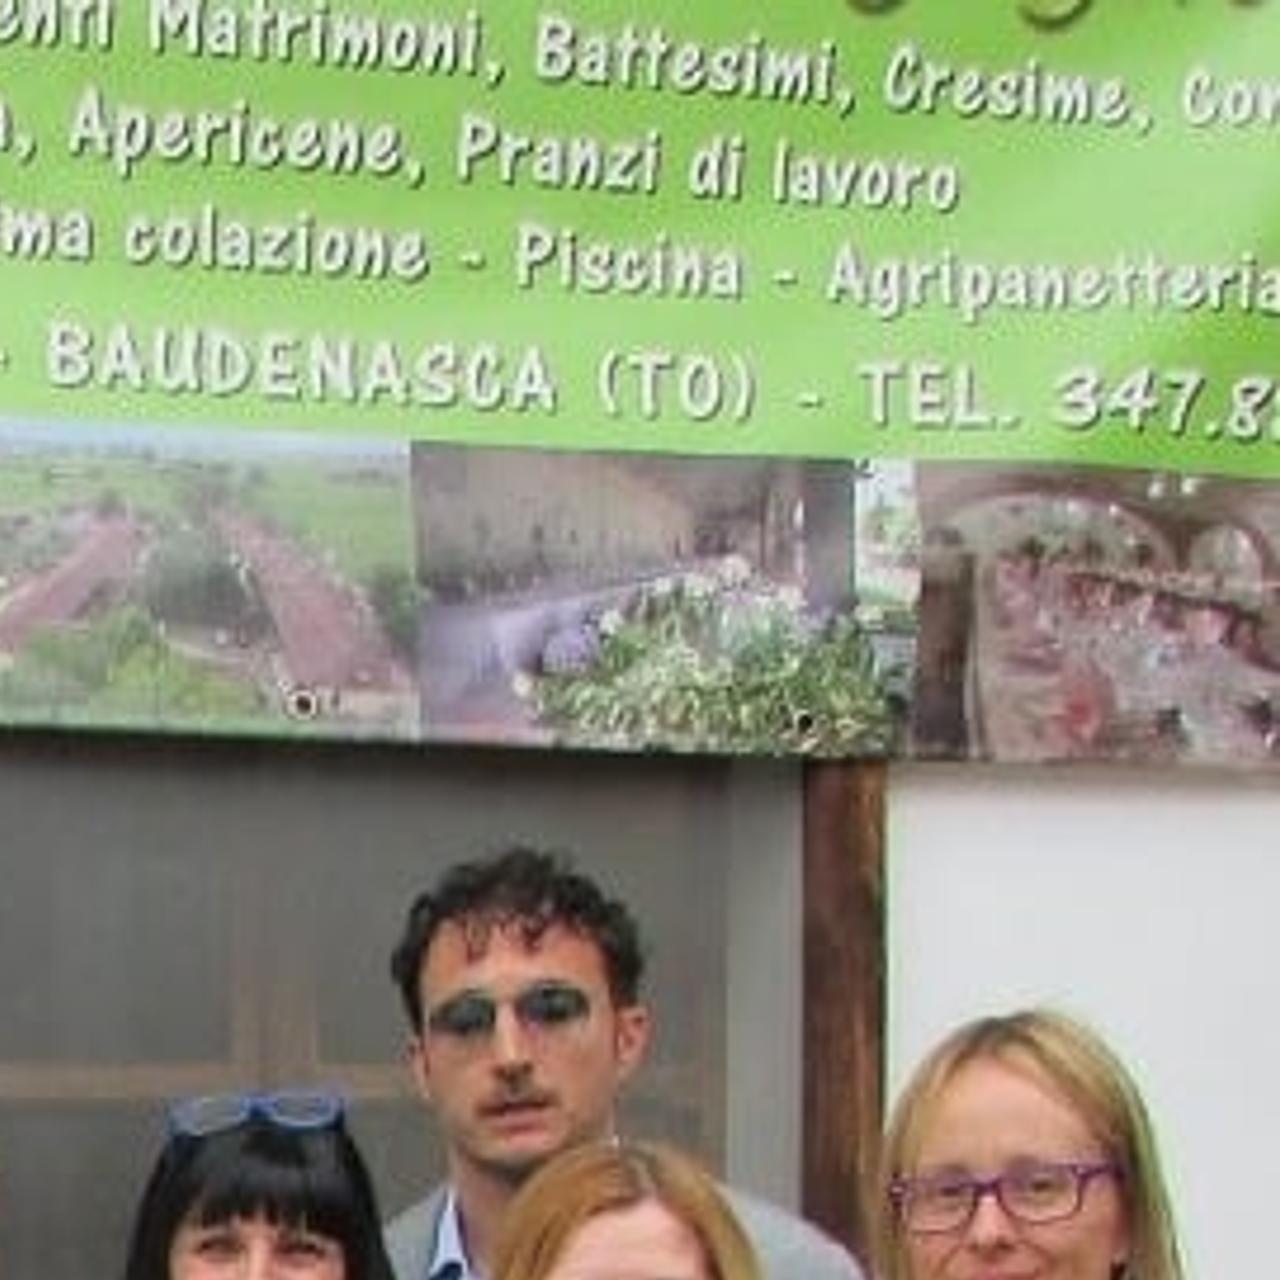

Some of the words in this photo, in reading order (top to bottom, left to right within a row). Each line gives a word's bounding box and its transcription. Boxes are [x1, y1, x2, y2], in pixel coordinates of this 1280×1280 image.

[147, 0, 504, 88] Matrimoni,
[537, 14, 855, 116] Battesimi,
[883, 42, 1154, 135] Cresime,
[69, 84, 426, 188] Apericene,
[456, 112, 663, 196] Pranzi
[688, 132, 745, 200] di
[773, 140, 961, 212] lavoro
[125, 204, 430, 282] colazione
[516, 226, 742, 300] Piscina
[826, 244, 1280, 322] Agripanetteria
[47, 320, 560, 414] BAUDENASCA
[598, 348, 758, 422] (TO)
[859, 366, 1022, 430] TEL.
[1054, 366, 1280, 446] 347.8
